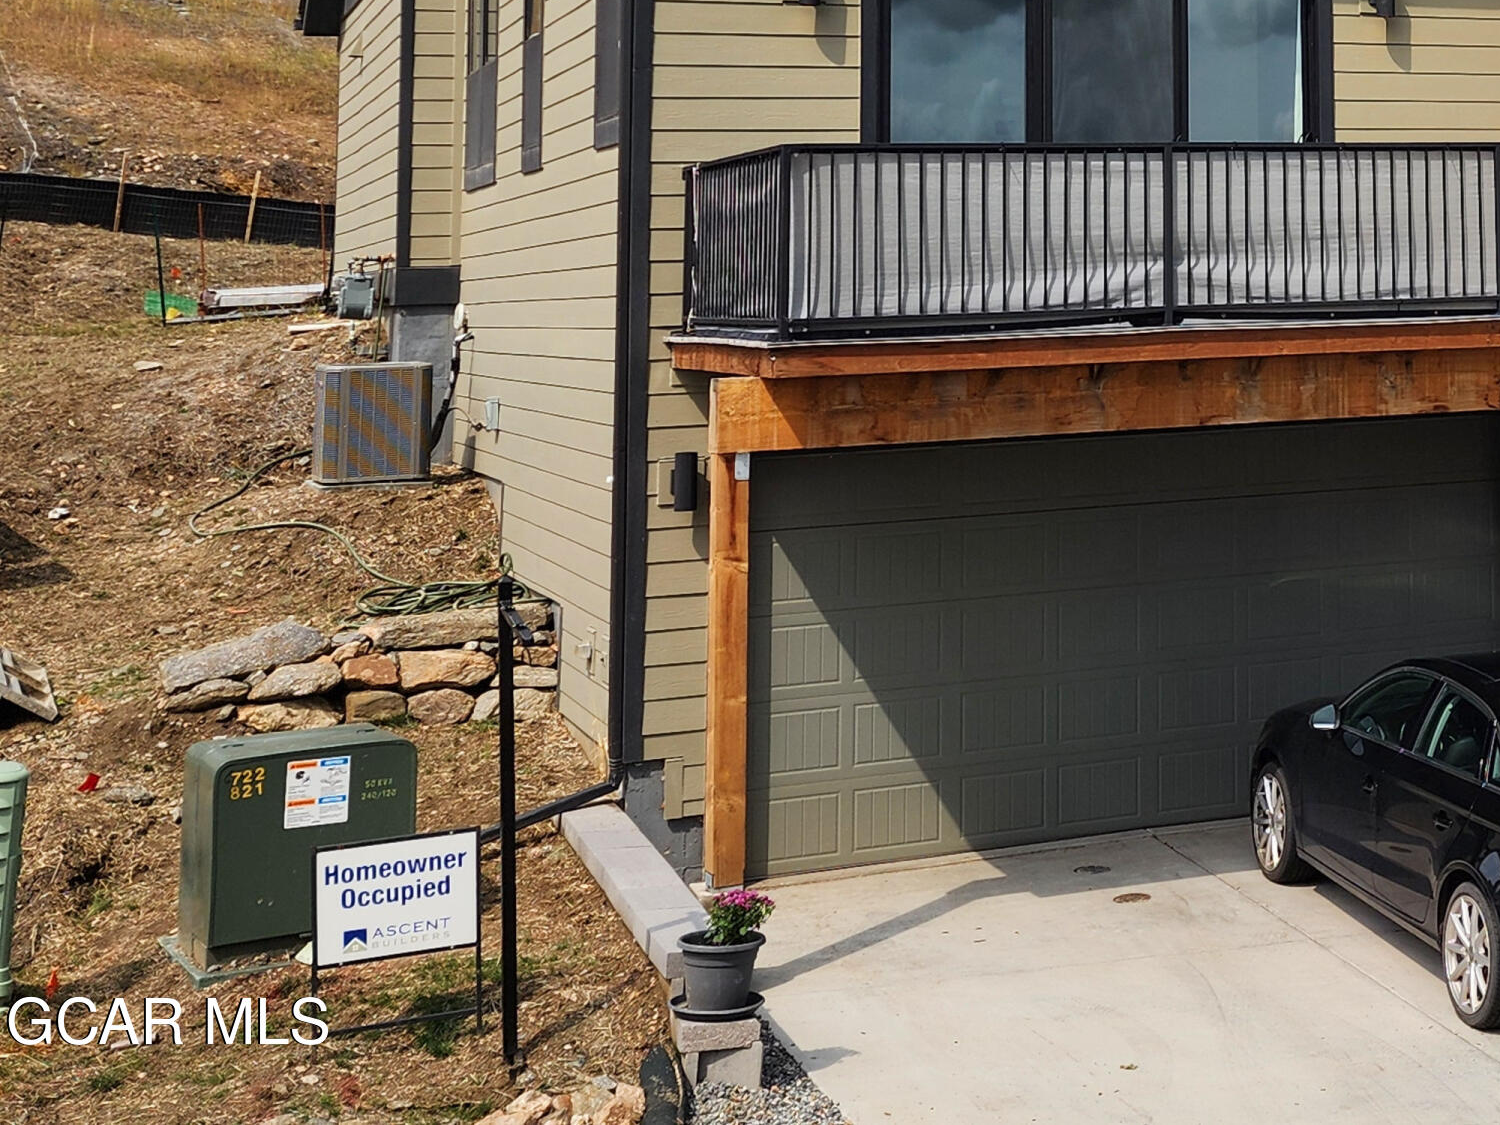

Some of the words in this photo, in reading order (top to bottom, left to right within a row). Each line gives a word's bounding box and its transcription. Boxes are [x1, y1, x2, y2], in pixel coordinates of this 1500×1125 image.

[231, 767, 265, 786] 722
[230, 783, 263, 801] 821
[324, 851, 467, 886] Homeowner
[341, 875, 451, 909] Occupied
[372, 917, 451, 939] ASCENT
[371, 930, 451, 949] BUILDERS
